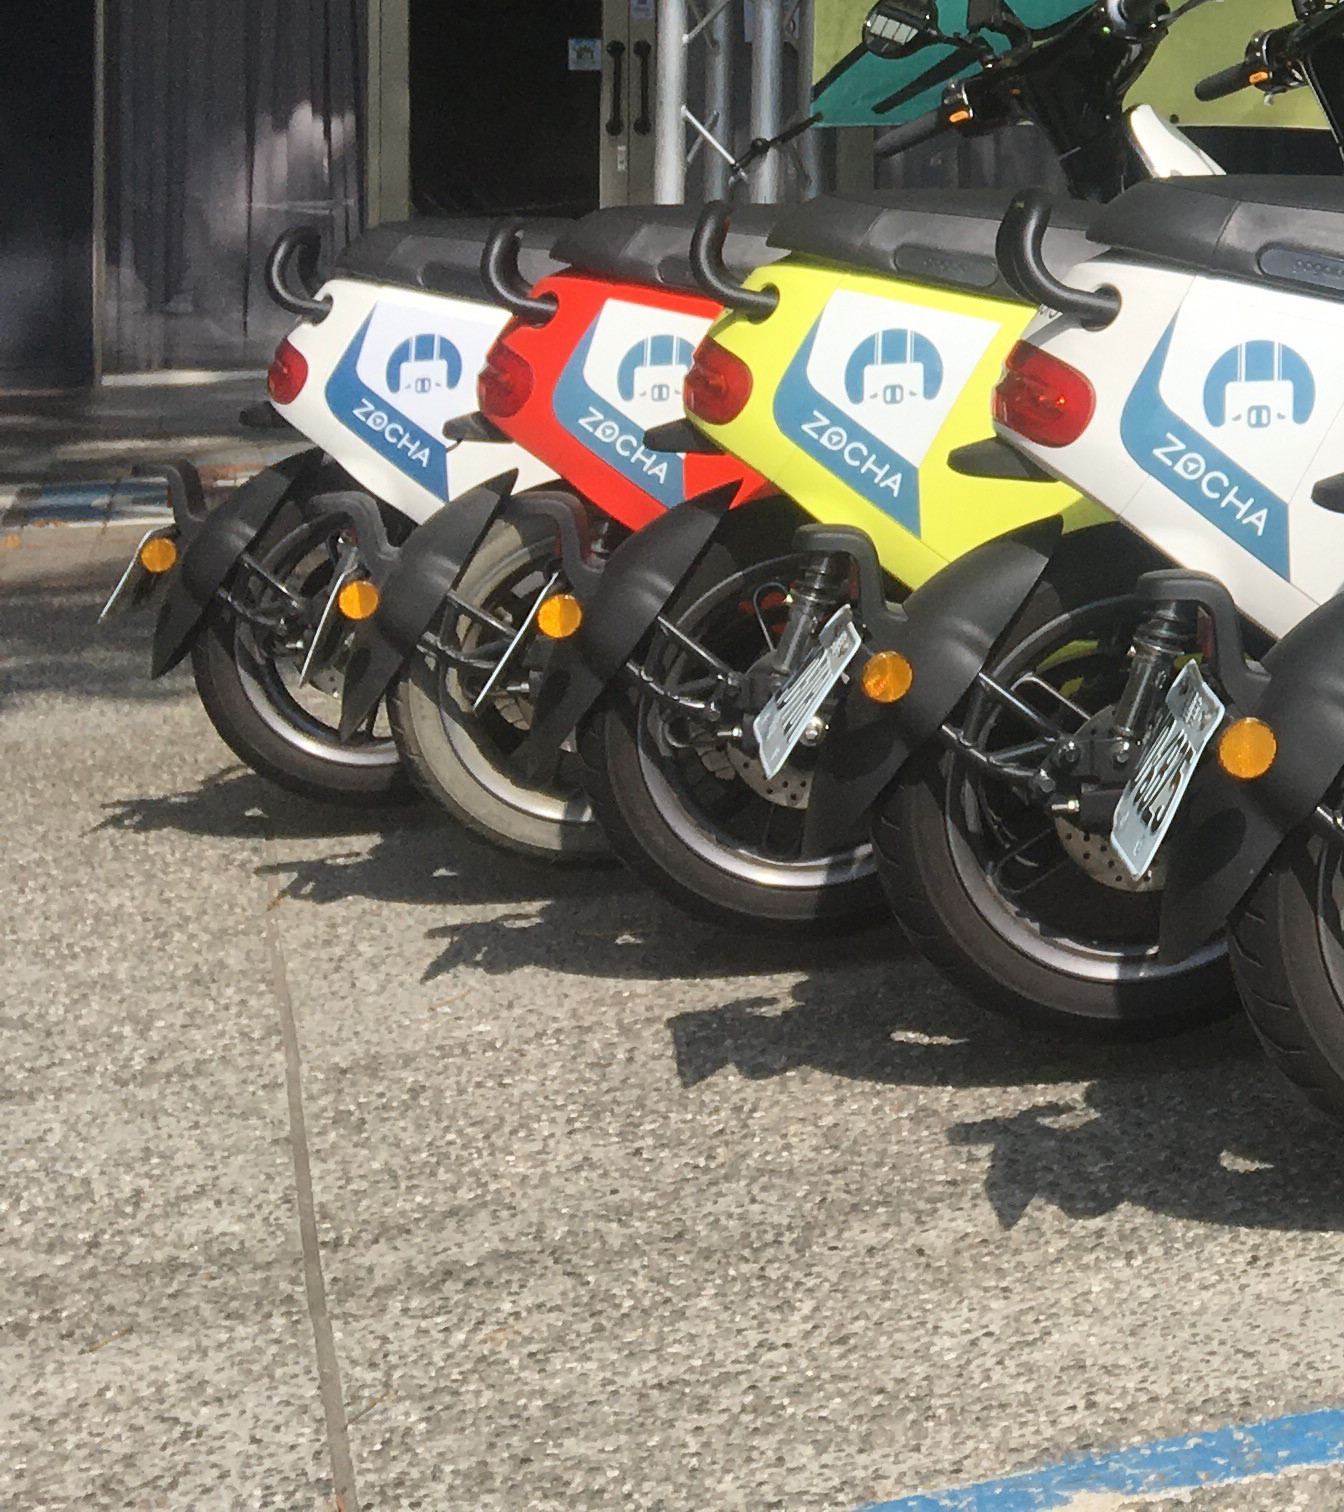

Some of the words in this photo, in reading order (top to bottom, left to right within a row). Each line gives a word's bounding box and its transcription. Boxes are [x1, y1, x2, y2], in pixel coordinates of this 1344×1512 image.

[352, 398, 433, 469] ZOCHA
[577, 406, 670, 486] ZOCHA
[800, 409, 905, 499] ZOCHA
[1151, 431, 1273, 537] ZOCHA
